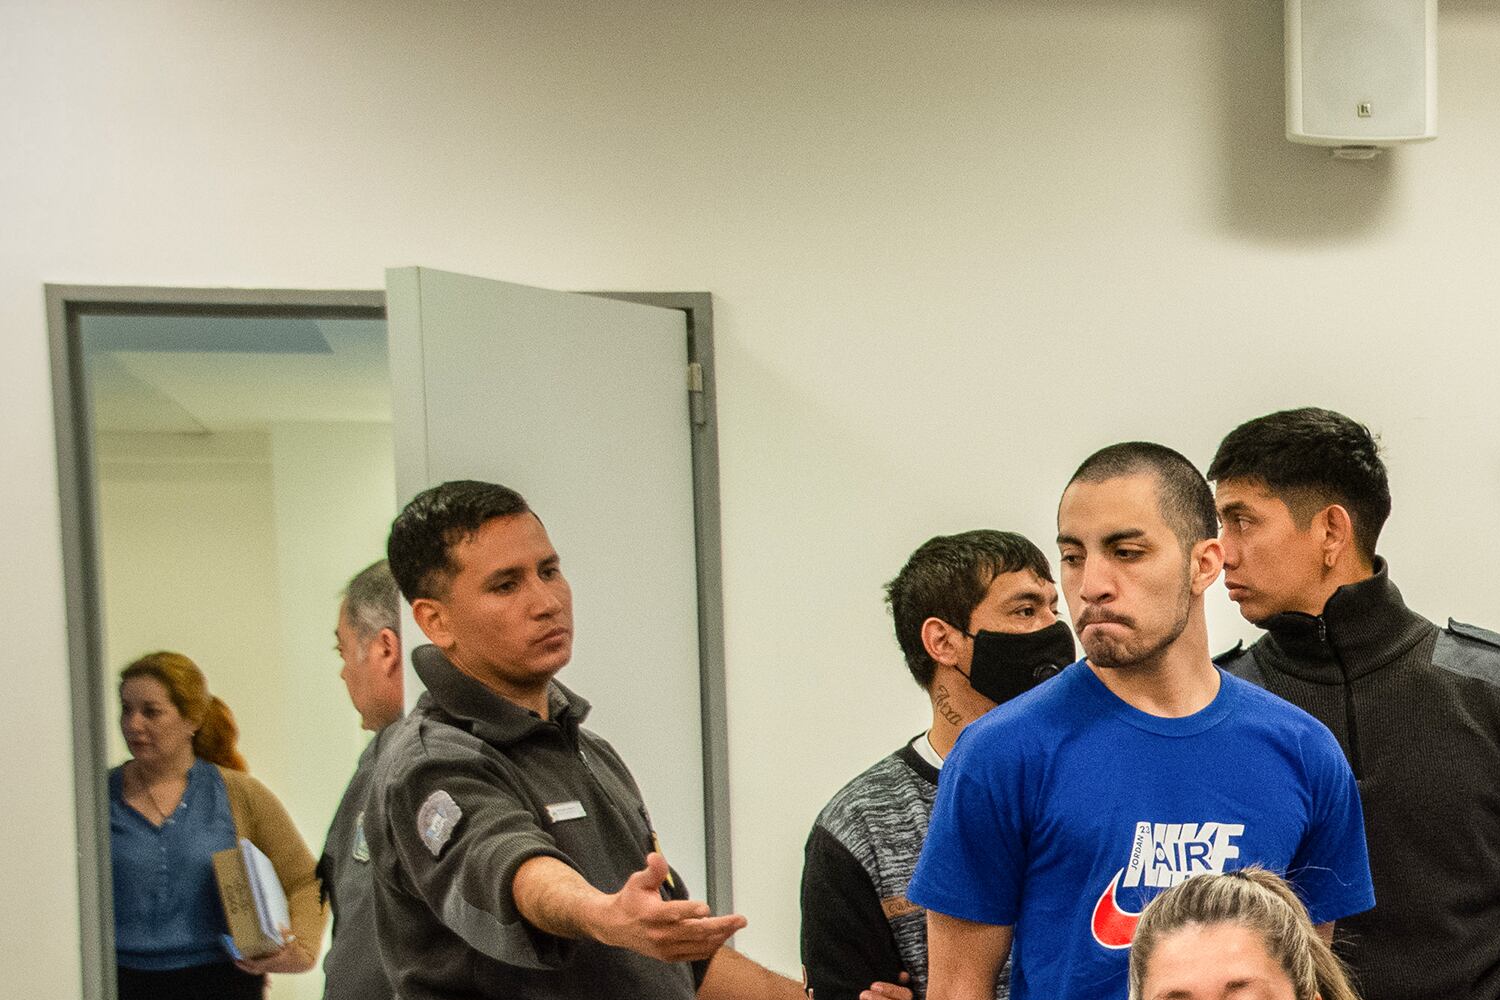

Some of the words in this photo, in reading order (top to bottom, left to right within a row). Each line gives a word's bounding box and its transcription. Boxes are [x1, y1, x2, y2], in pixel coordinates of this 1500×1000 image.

[1123, 822, 1245, 888] NIKE
[1131, 835, 1144, 871] JORDAN
[1152, 841, 1213, 872] AIR
